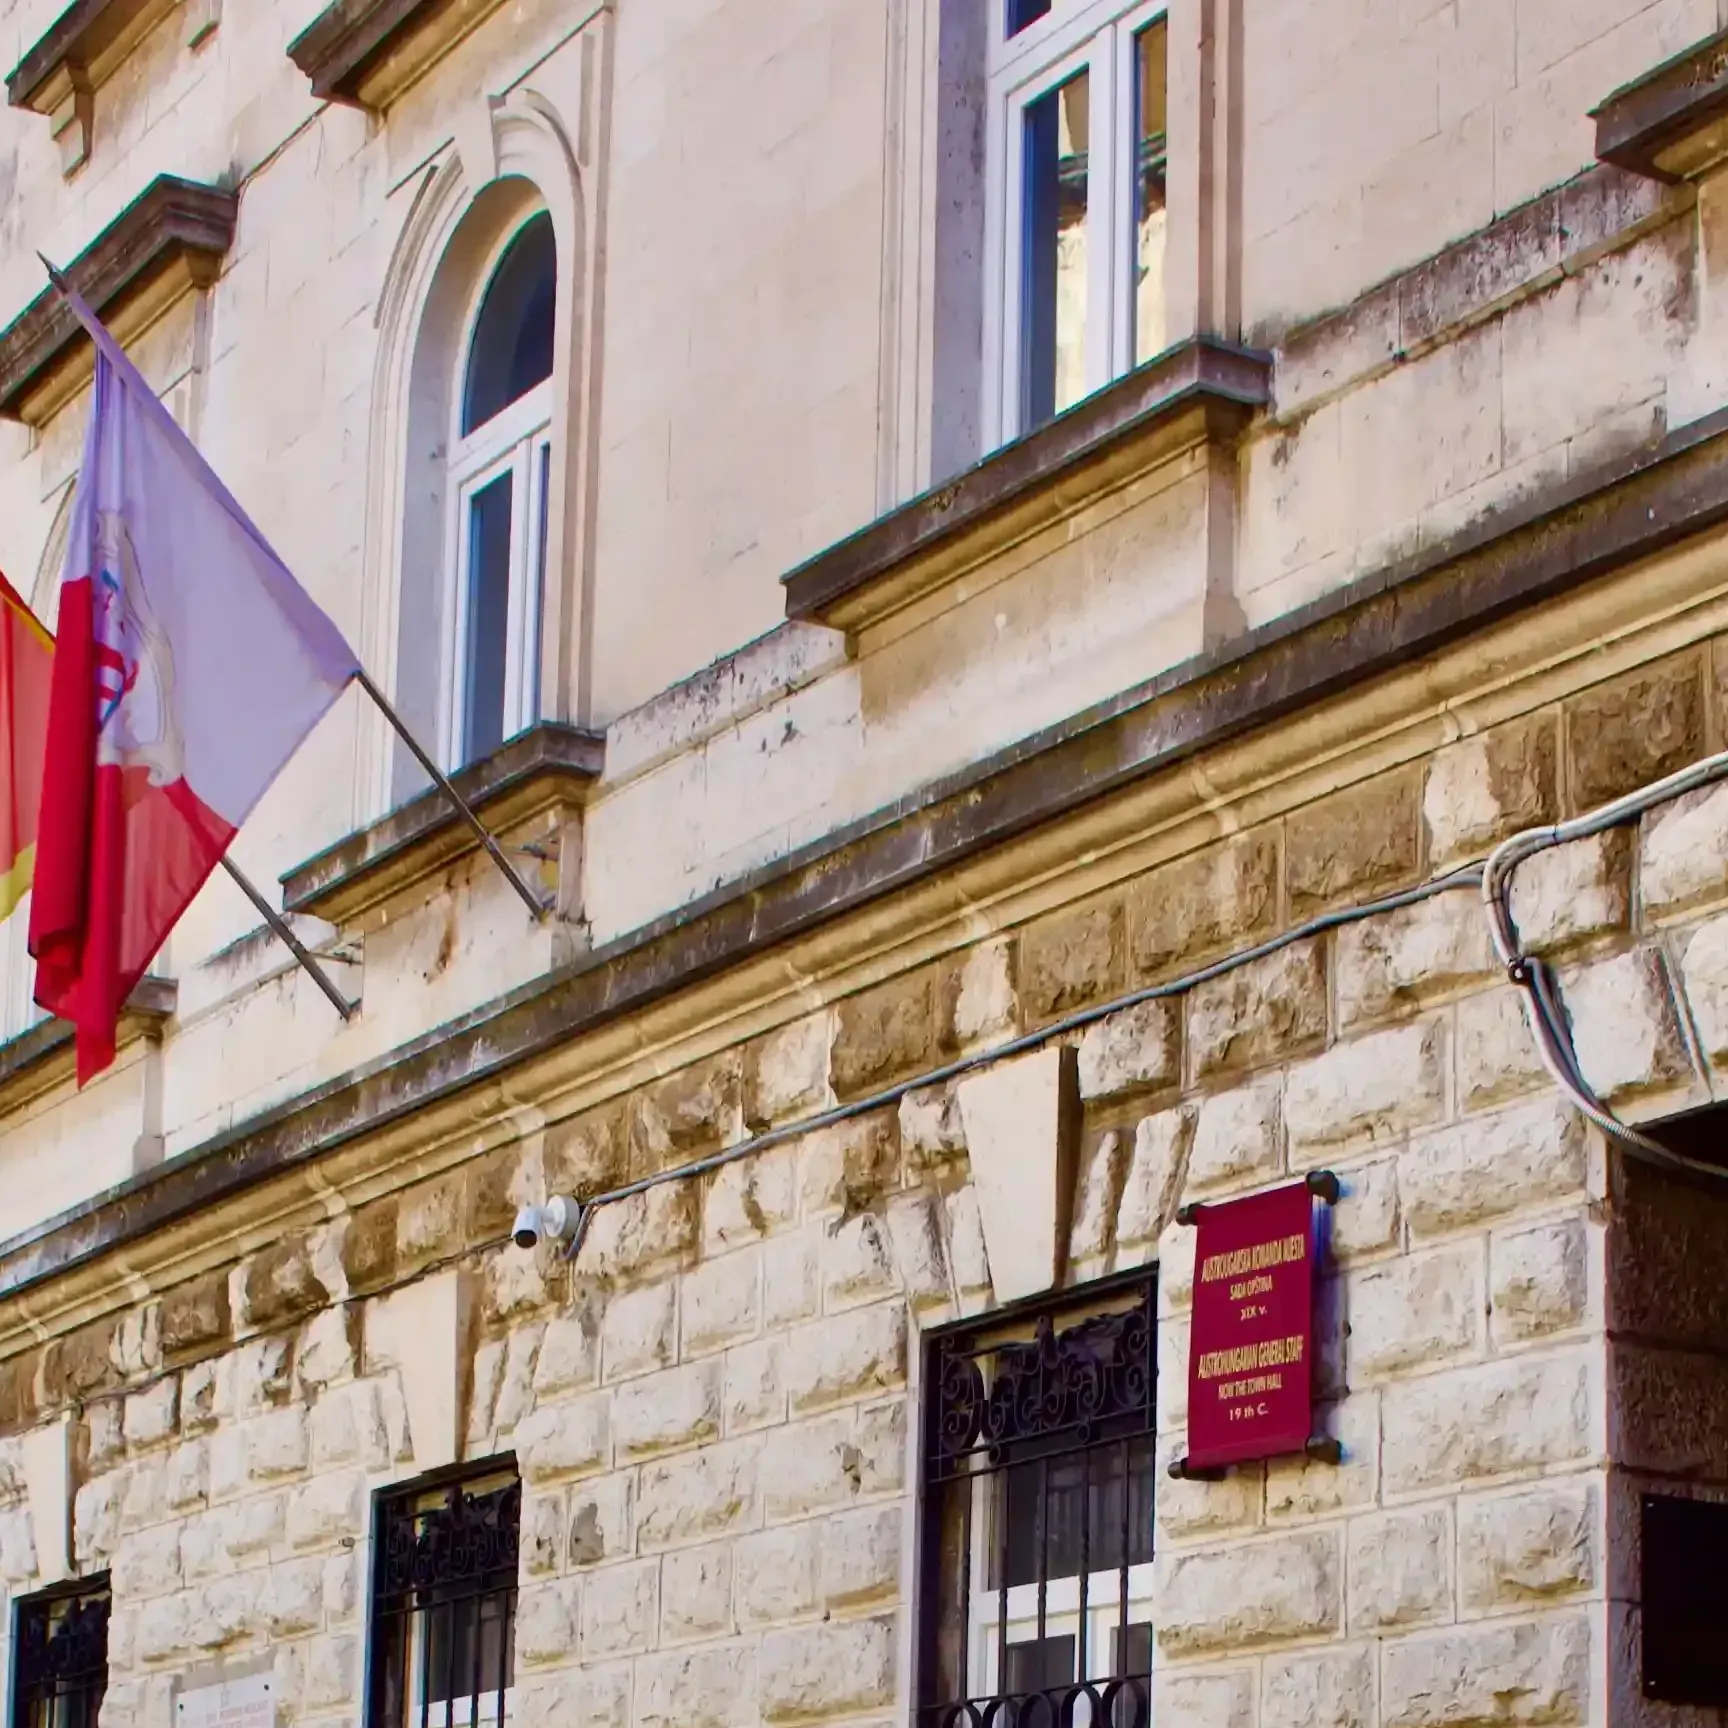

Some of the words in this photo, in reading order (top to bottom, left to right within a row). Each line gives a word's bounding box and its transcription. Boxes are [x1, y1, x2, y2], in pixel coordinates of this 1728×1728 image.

[1230, 1281, 1247, 1300] SADA
[1240, 1305, 1257, 1321] XIX
[1258, 1339, 1286, 1367] GENERAL
[1285, 1334, 1304, 1363] STAFF
[1218, 1381, 1234, 1400] NOW
[1235, 1379, 1247, 1396] THE
[1247, 1376, 1266, 1395] TOWN
[1266, 1372, 1282, 1391] HALL
[1229, 1407, 1242, 1421] 19
[1243, 1404, 1255, 1419] th
